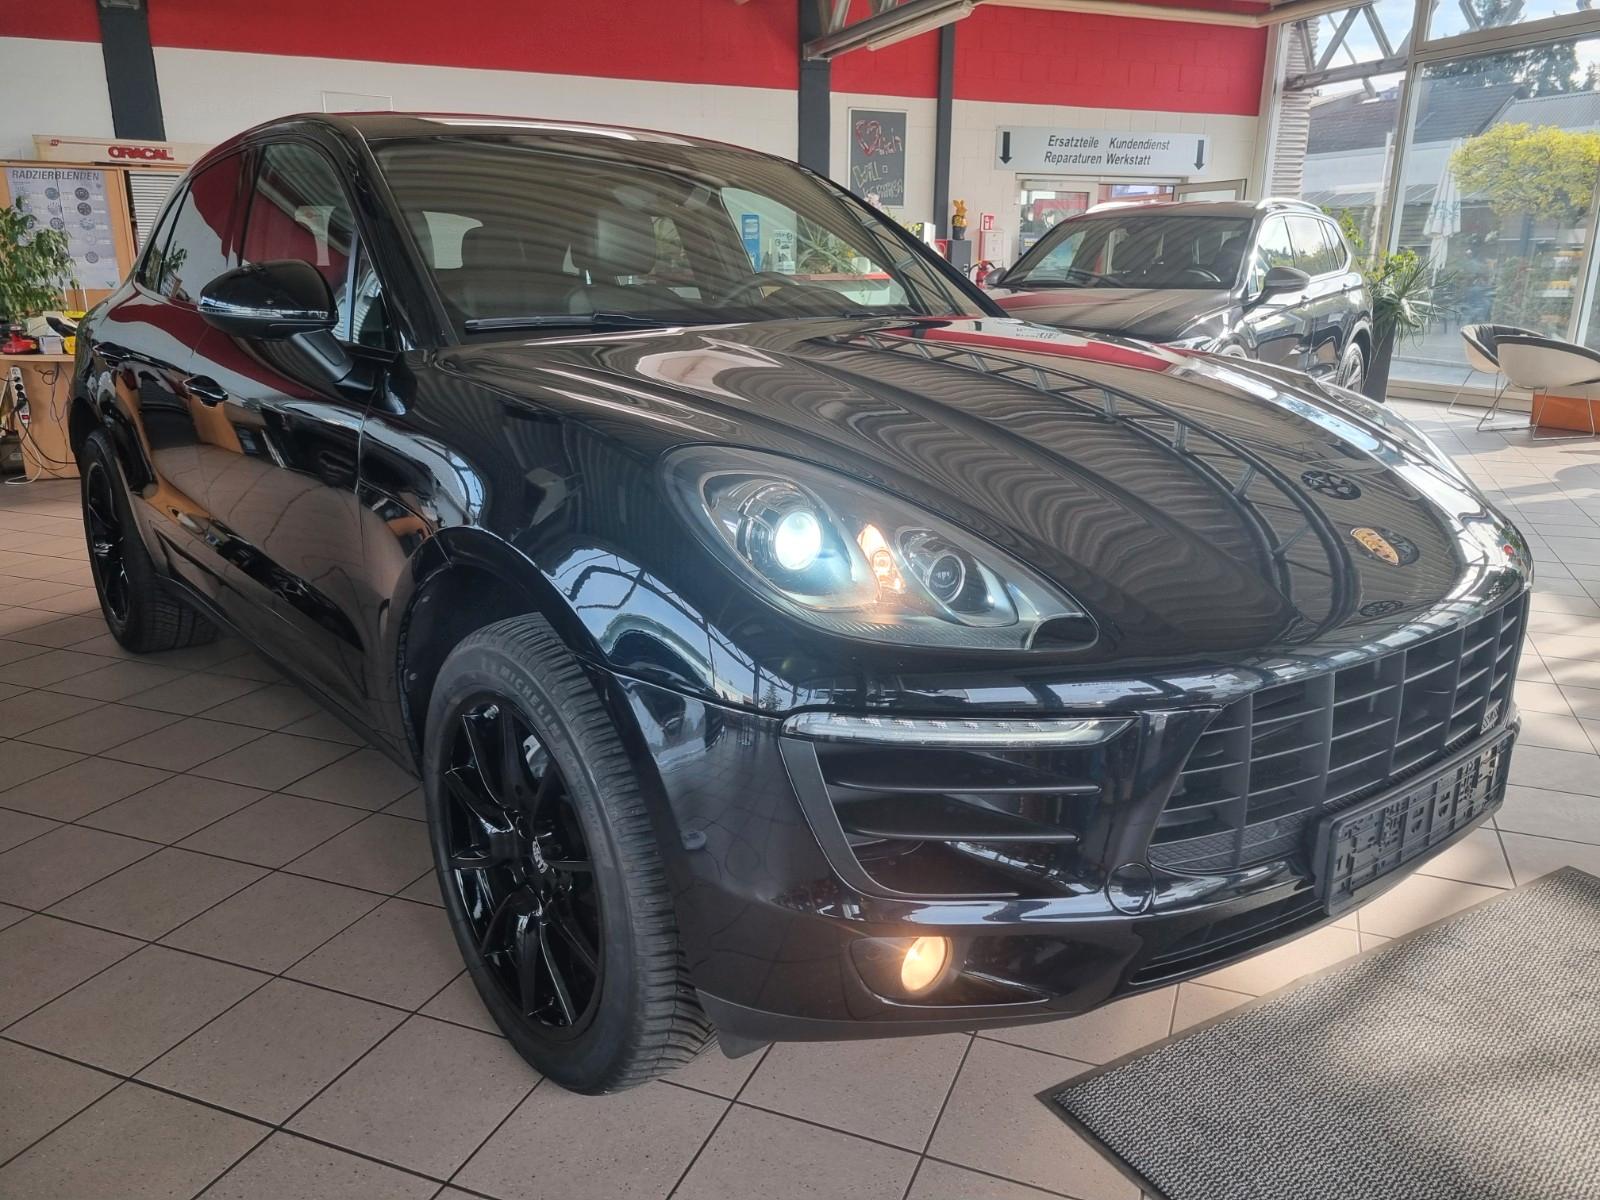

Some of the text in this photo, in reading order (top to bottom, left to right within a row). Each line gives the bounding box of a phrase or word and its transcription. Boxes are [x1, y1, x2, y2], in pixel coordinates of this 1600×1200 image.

[1047, 134, 1170, 151] Ersatzteile Kundendienst
[108, 146, 174, 161] ORACAL
[1044, 150, 1152, 166] Reparaturen Werkstatt
[12, 169, 99, 181] RADZIERBLENDEN
[499, 666, 561, 739] MICHELIN
